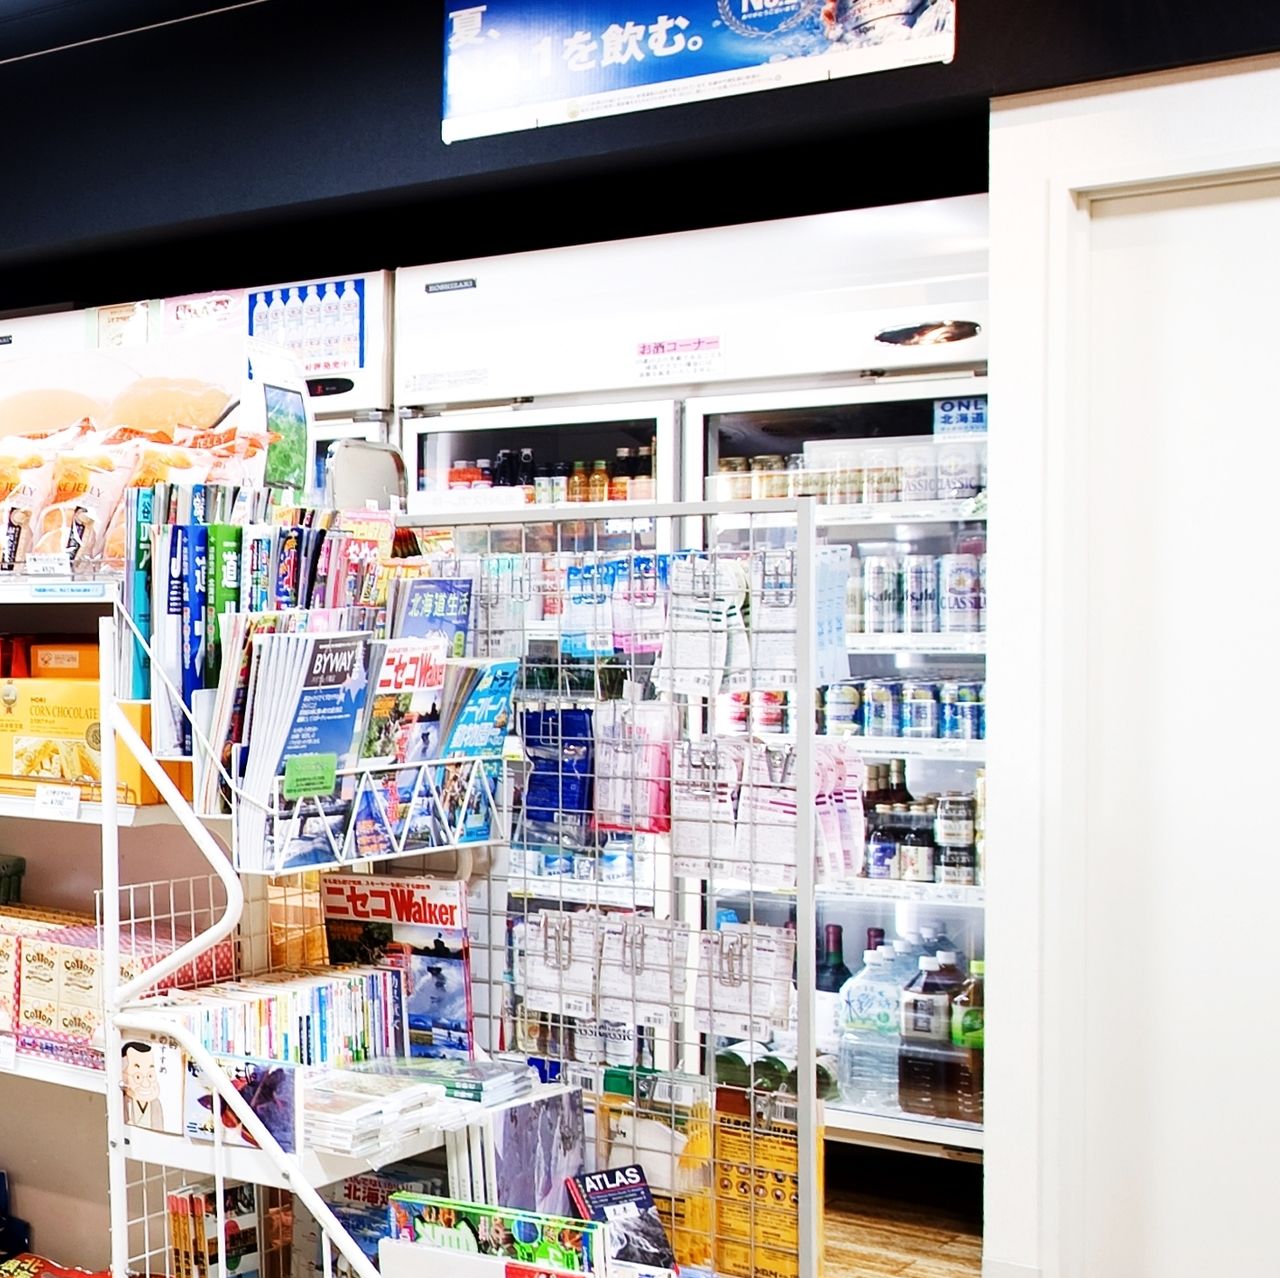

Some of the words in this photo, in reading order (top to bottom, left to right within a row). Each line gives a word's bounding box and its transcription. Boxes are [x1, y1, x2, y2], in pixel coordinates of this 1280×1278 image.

[639, 336, 720, 355] お酒コーナー
[941, 413, 983, 425] 北海道
[197, 435, 226, 448] JELLY
[10, 482, 37, 498] JELLY
[72, 483, 105, 498] JELLY
[408, 592, 470, 617] 北海道生活
[313, 651, 355, 675] BYWAY
[30, 705, 52, 717] CORN
[52, 705, 98, 720] CHOCOLATE
[325, 885, 458, 927] ニセコWalker
[585, 1167, 641, 1193] ATLAS
